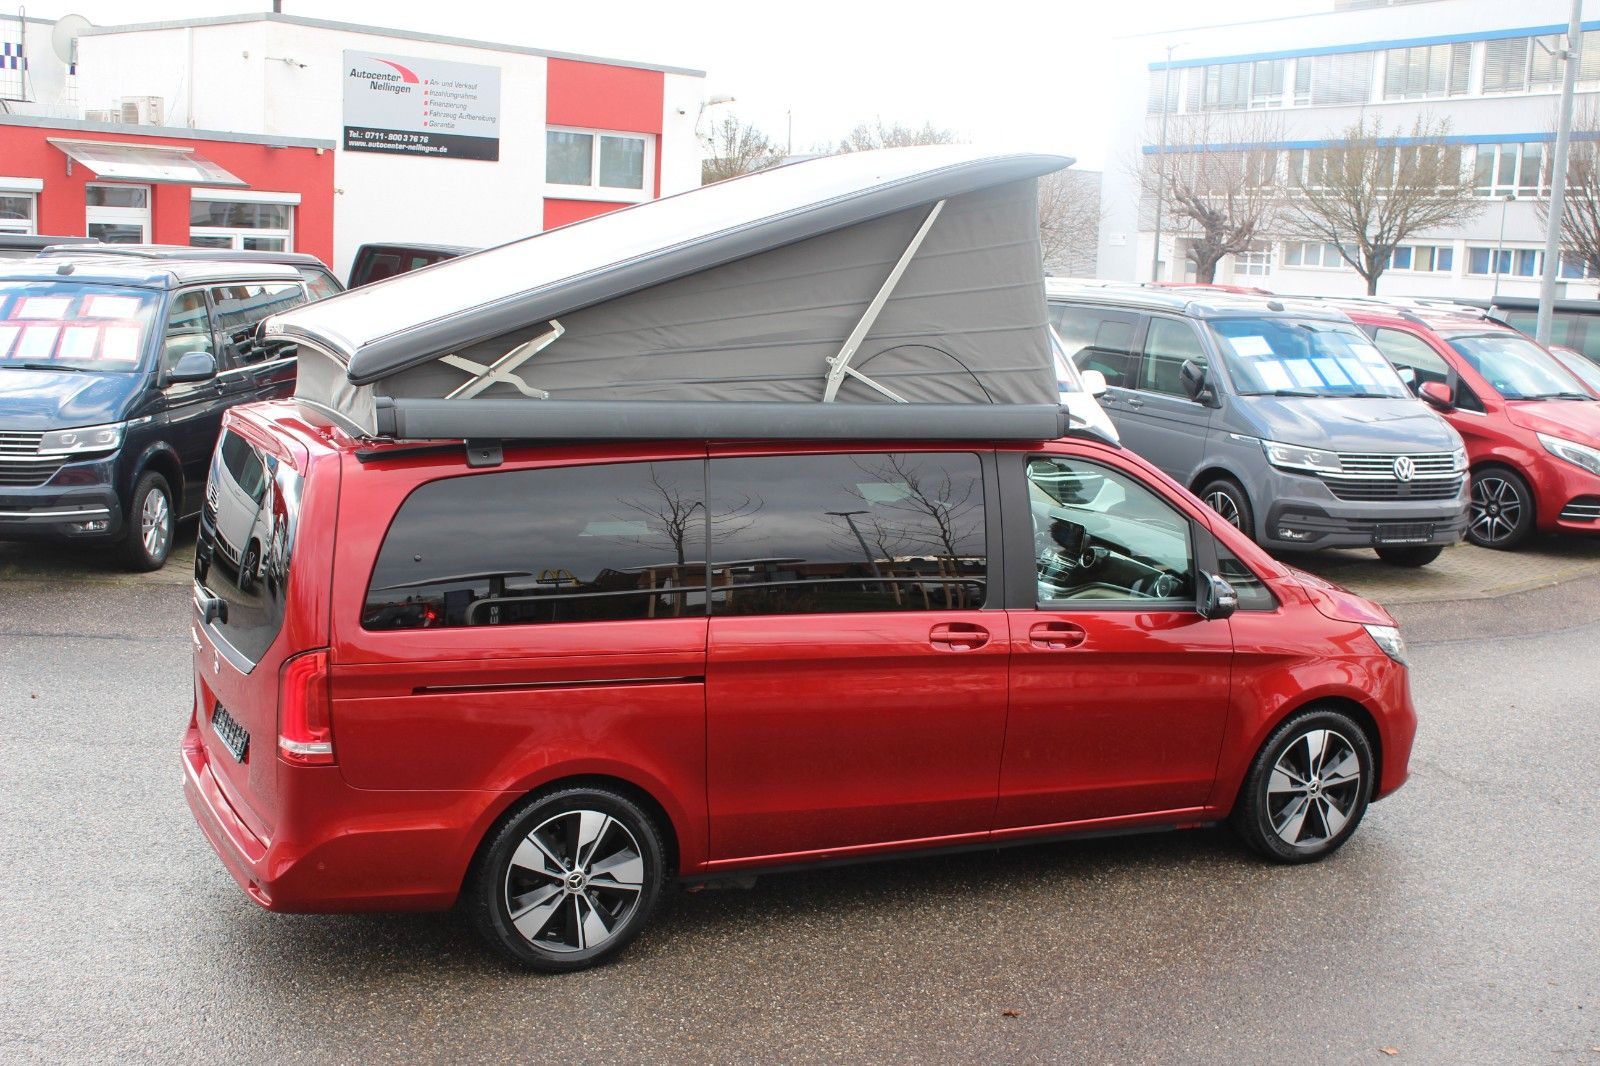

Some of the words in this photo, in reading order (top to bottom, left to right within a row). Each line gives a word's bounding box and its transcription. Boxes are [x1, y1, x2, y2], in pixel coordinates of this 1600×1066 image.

[350, 68, 401, 81] Autocenter
[370, 80, 411, 95] Nellingen
[441, 80, 453, 88] und
[454, 81, 478, 90] Verkauf
[429, 99, 467, 111] Finanzierung
[429, 109, 457, 121] Fahrzeug
[429, 120, 455, 129] Garantie
